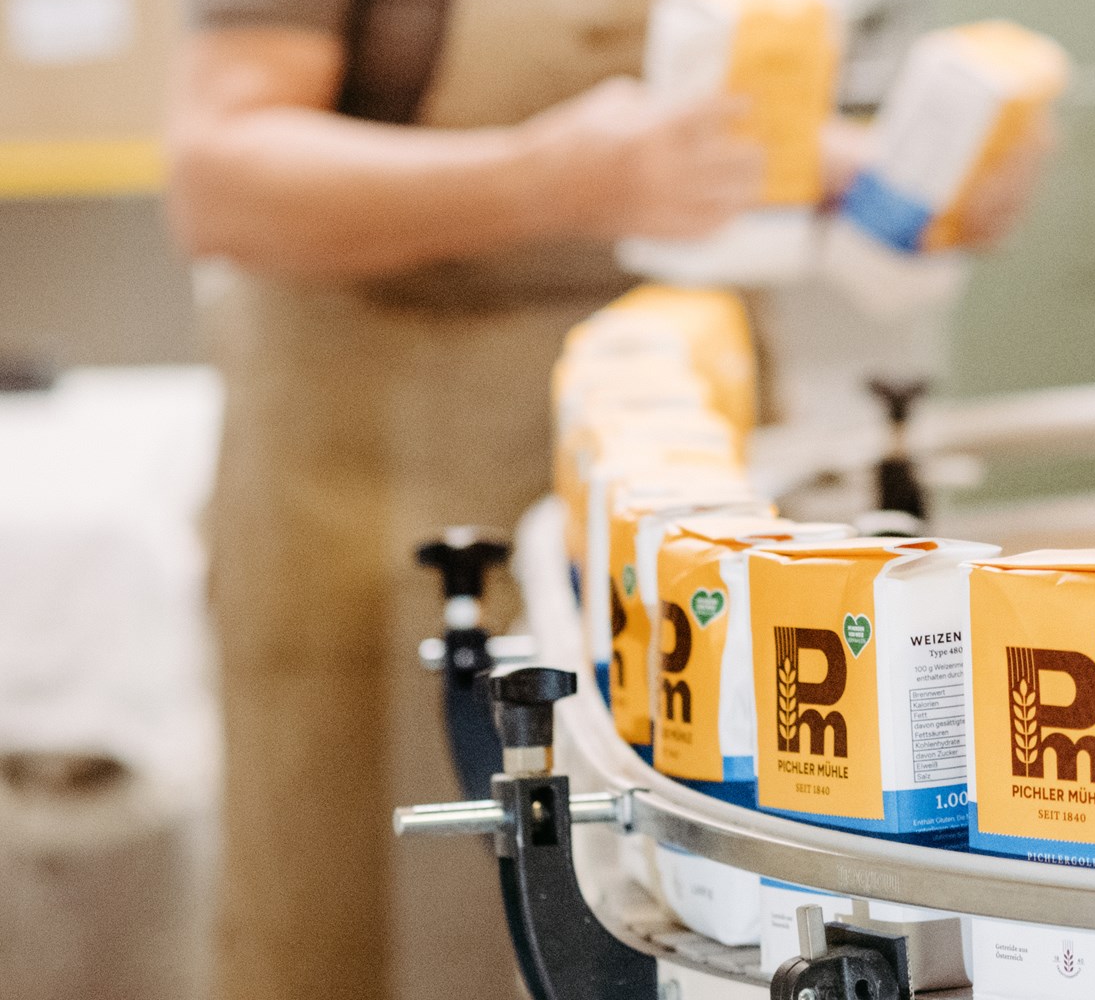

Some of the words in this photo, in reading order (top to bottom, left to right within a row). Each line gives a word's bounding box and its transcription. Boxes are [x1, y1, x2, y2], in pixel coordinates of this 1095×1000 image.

[910, 631, 962, 646] WEIZEN
[929, 649, 948, 659] Type
[778, 760, 815, 777] PICHLER
[817, 761, 849, 779] MÜHLE
[796, 783, 812, 794] SEIT
[813, 784, 830, 796] 1840
[1012, 784, 1064, 802] PICHLER
[1038, 809, 1061, 822] SEIT
[1063, 810, 1087, 823] 1840
[995, 943, 1018, 952] Getreide
[995, 951, 1023, 962] Österreich
